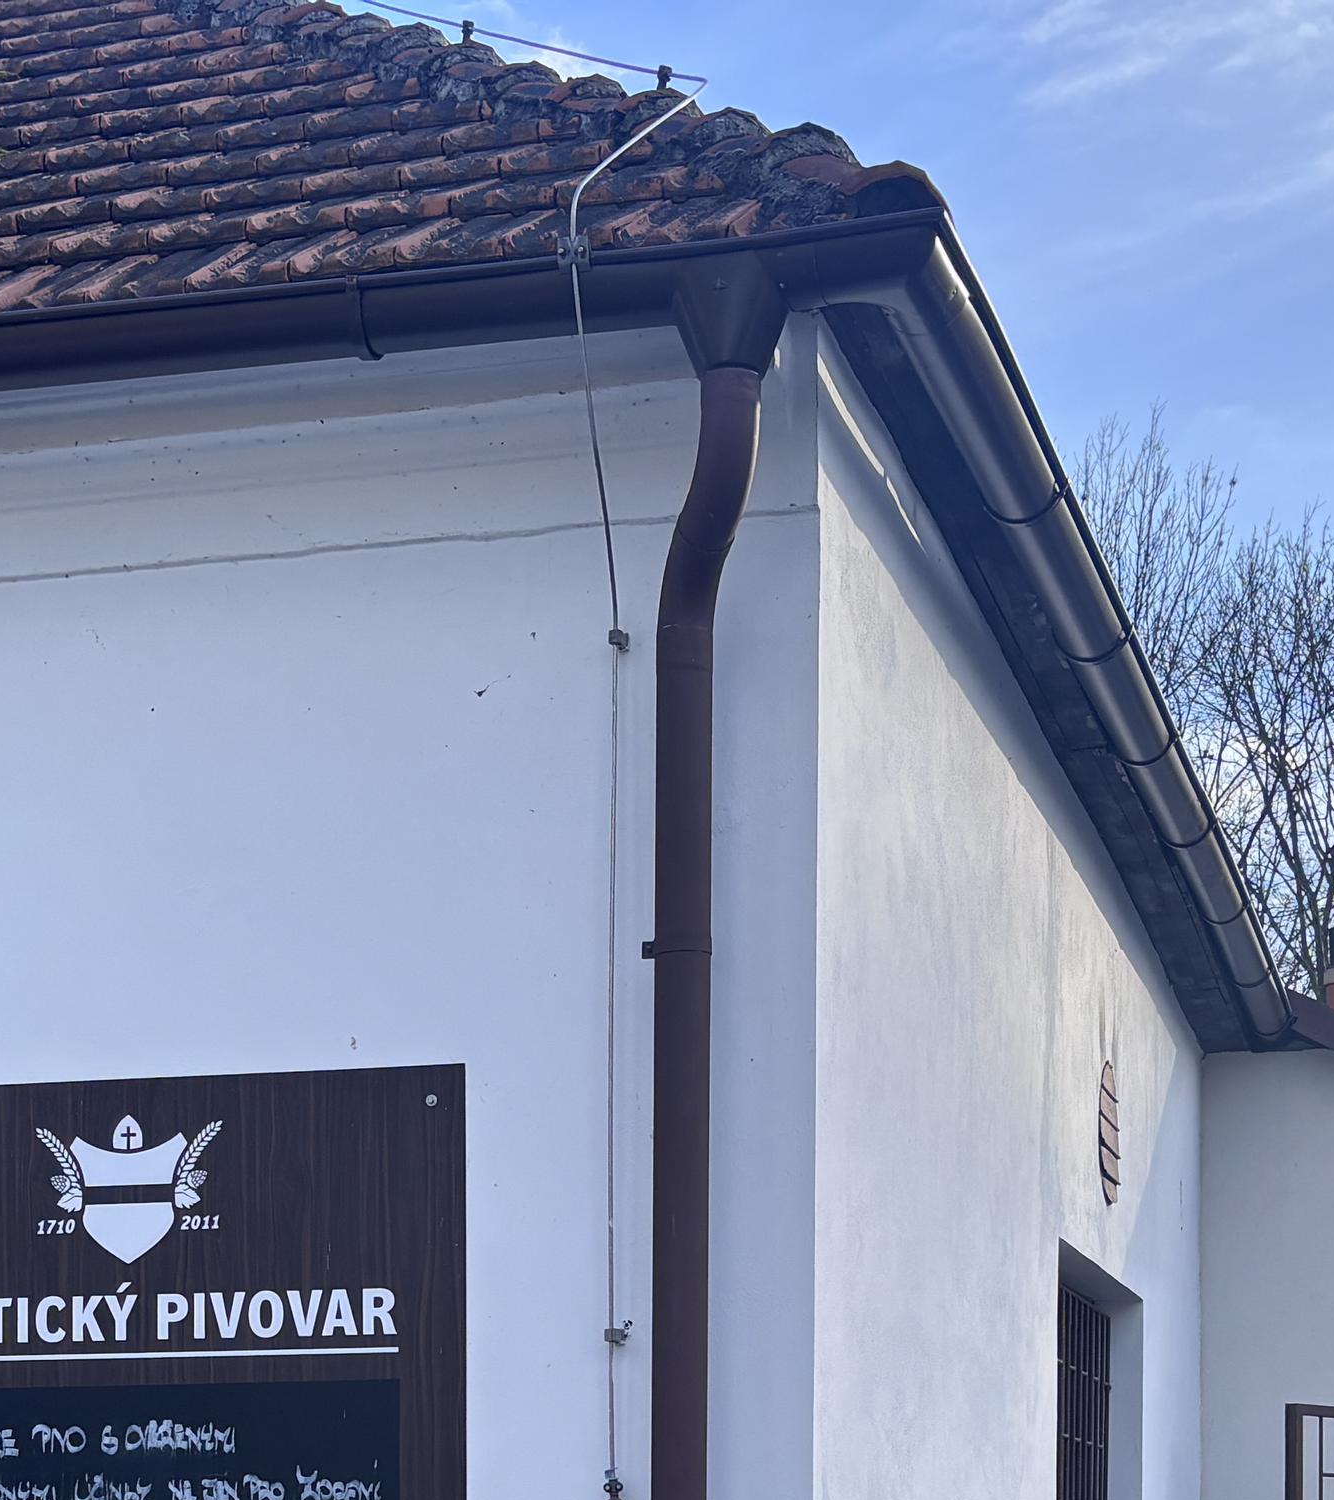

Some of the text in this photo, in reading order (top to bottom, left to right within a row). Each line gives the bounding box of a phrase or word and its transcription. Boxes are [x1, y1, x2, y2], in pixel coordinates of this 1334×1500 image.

[36, 1219, 76, 1235] 1710
[180, 1214, 220, 1231] 2011
[157, 1287, 398, 1340] PIVOVAR
